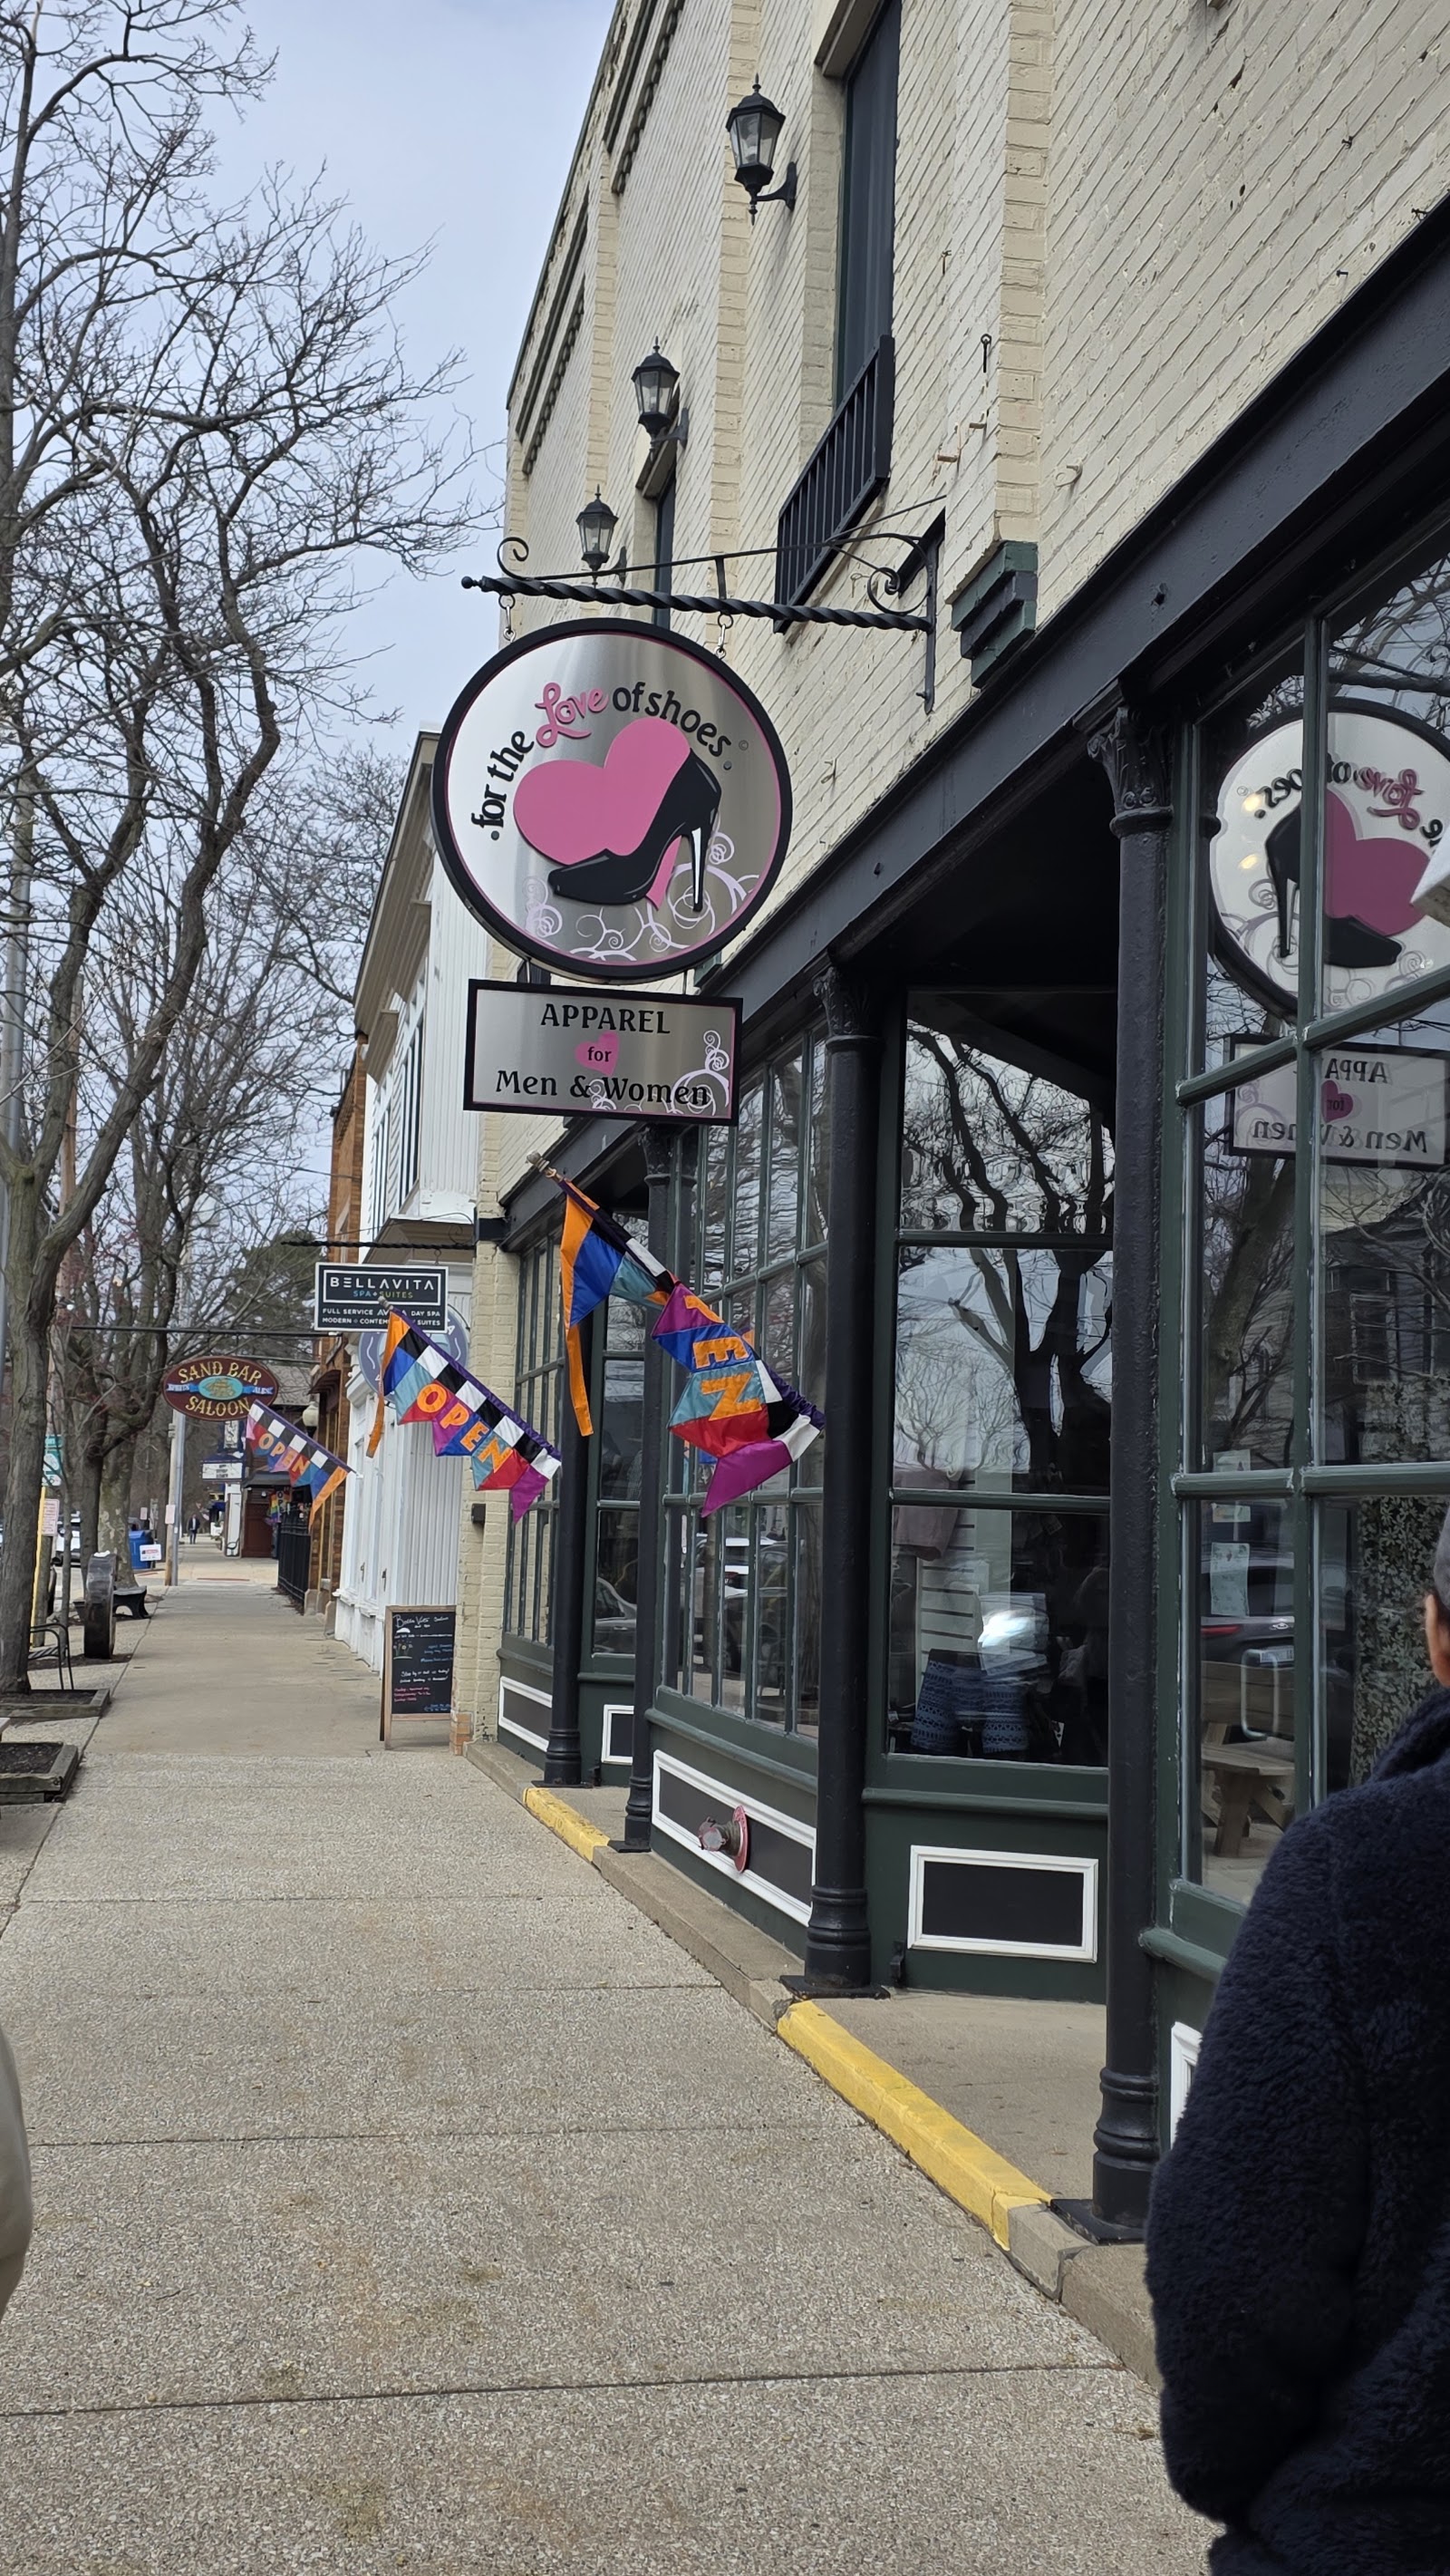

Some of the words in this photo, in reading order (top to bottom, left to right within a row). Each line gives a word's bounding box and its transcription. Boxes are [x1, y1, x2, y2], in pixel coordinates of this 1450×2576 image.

[535, 682, 609, 748] Love
[487, 730, 535, 782] the
[471, 783, 508, 828] for
[540, 1003, 671, 1034] APPAREL
[587, 1046, 612, 1062] for
[496, 1070, 557, 1096] Men
[569, 1075, 591, 1098] &
[600, 1077, 711, 1105] Women
[379, 1291, 413, 1299] SUITES
[178, 1361, 223, 1384] SAND
[227, 1362, 262, 1386] BAR
[185, 1396, 250, 1417] SALOON
[417, 1383, 514, 1474] OPEN
[258, 1432, 311, 1477] OPEN
